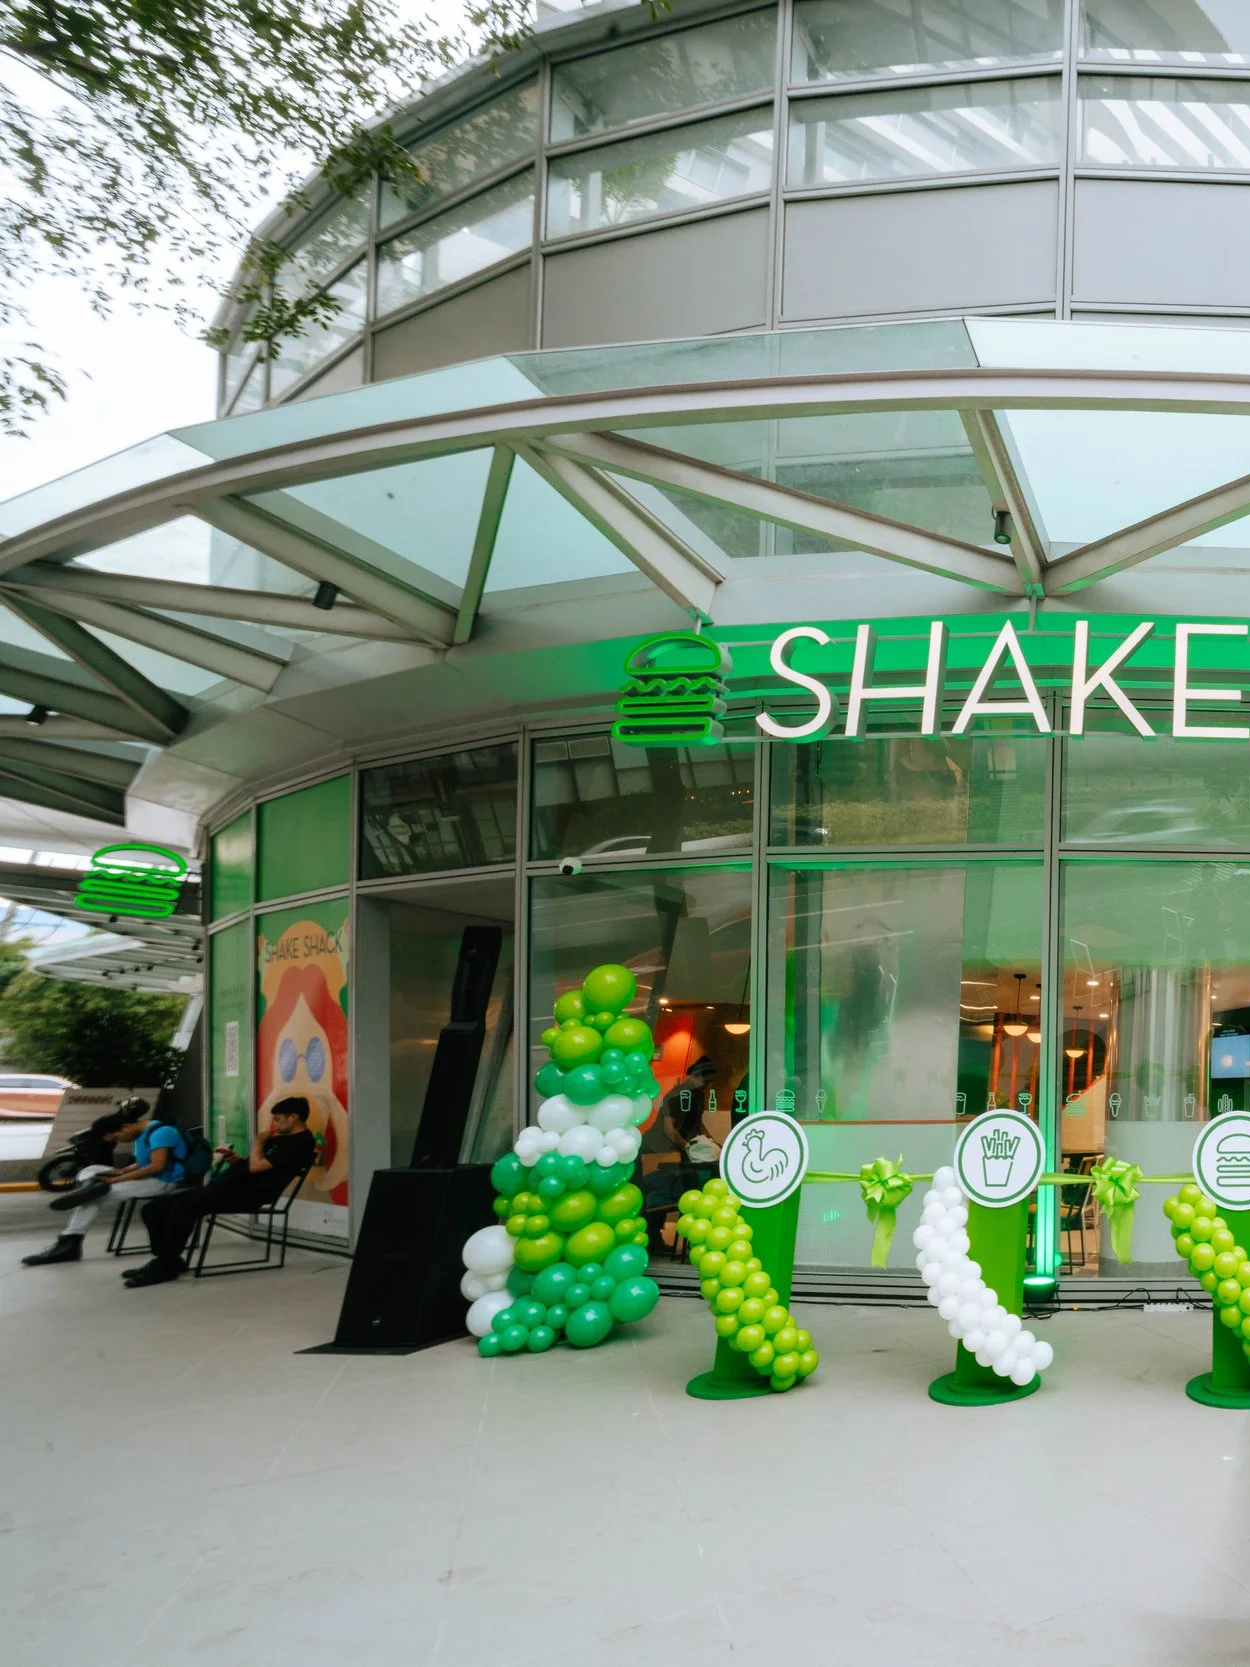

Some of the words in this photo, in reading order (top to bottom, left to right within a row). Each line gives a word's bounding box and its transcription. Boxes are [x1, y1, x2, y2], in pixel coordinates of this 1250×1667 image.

[755, 619, 1250, 741] SHAKE
[265, 936, 299, 963] SHAKE
[303, 929, 343, 958] SHACK
